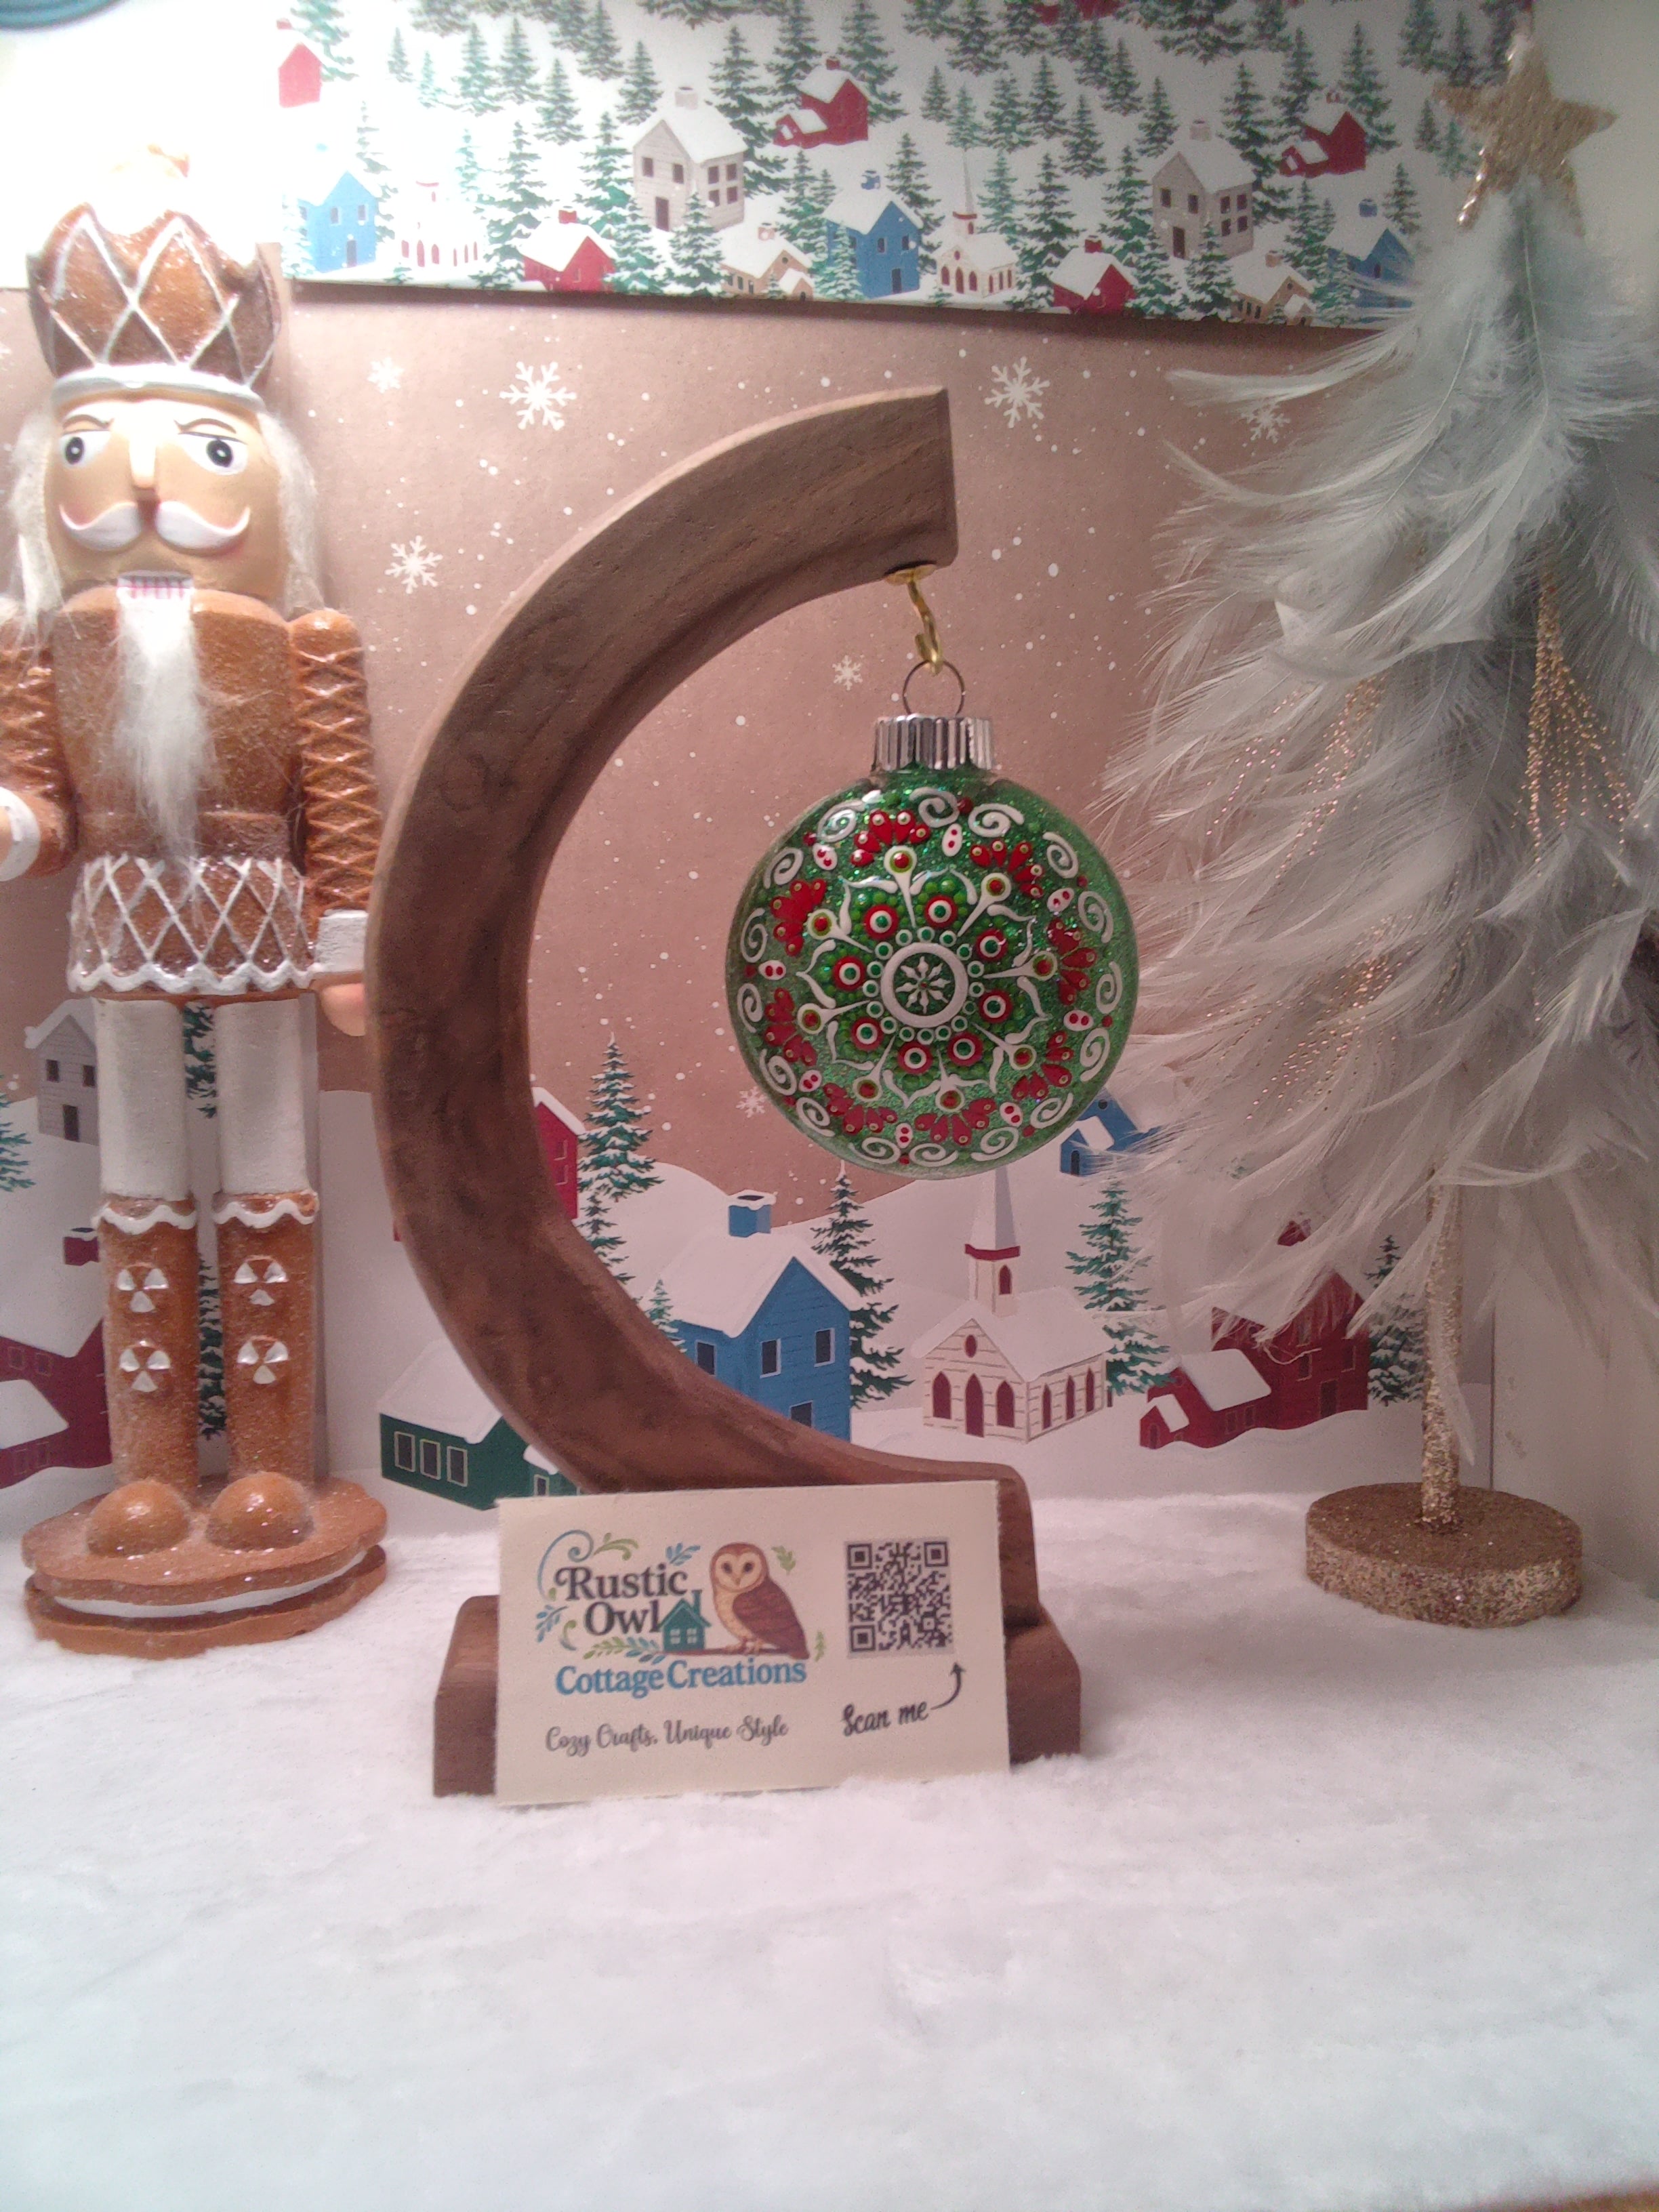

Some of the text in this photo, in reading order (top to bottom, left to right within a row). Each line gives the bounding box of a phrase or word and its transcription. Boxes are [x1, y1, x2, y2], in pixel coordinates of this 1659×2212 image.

[554, 1563, 688, 1601] Rustic
[584, 1598, 660, 1635] Owl
[556, 1659, 806, 1699] Cottage Creations
[546, 1726, 591, 1757] Cozy
[664, 1719, 732, 1749] Unique
[737, 1715, 789, 1746] Style
[842, 1702, 928, 1736] Scan me
